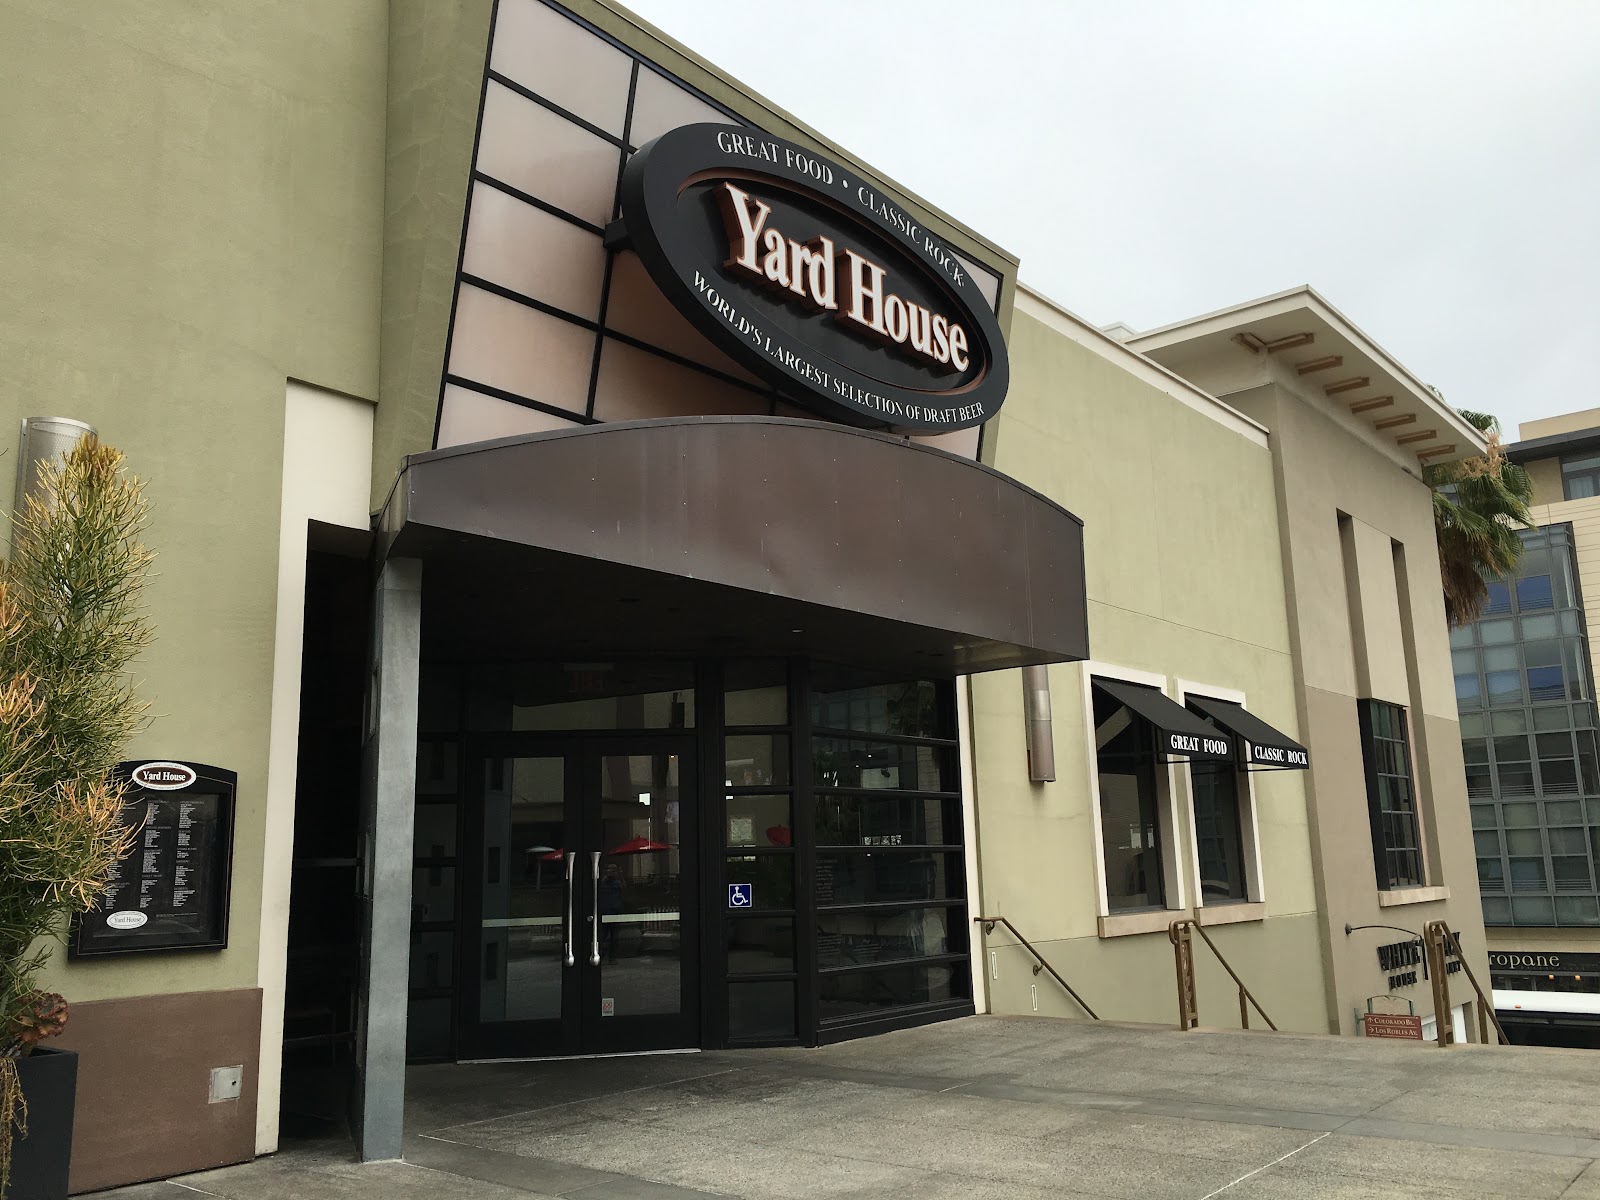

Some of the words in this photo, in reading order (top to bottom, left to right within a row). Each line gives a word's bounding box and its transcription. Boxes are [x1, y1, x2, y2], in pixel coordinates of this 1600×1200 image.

[717, 131, 780, 163] GREAT
[785, 148, 833, 185] FOOD
[857, 186, 921, 244] CLASSIC
[924, 240, 965, 287] ROCK
[725, 181, 838, 310] Yard
[845, 248, 970, 373] House
[693, 270, 763, 346] WORLD'S
[764, 337, 831, 388] LARGEST
[833, 378, 903, 416] SELECTION
[905, 404, 921, 420] OF
[923, 407, 959, 423] DRAFT
[959, 401, 985, 422] BEER
[143, 770, 162, 781] Yard
[163, 771, 186, 782] House
[1171, 734, 1199, 752] GREAT
[1203, 738, 1228, 755] FOOD
[1254, 745, 1285, 762] CLASSIC
[1287, 750, 1308, 765] ROCK
